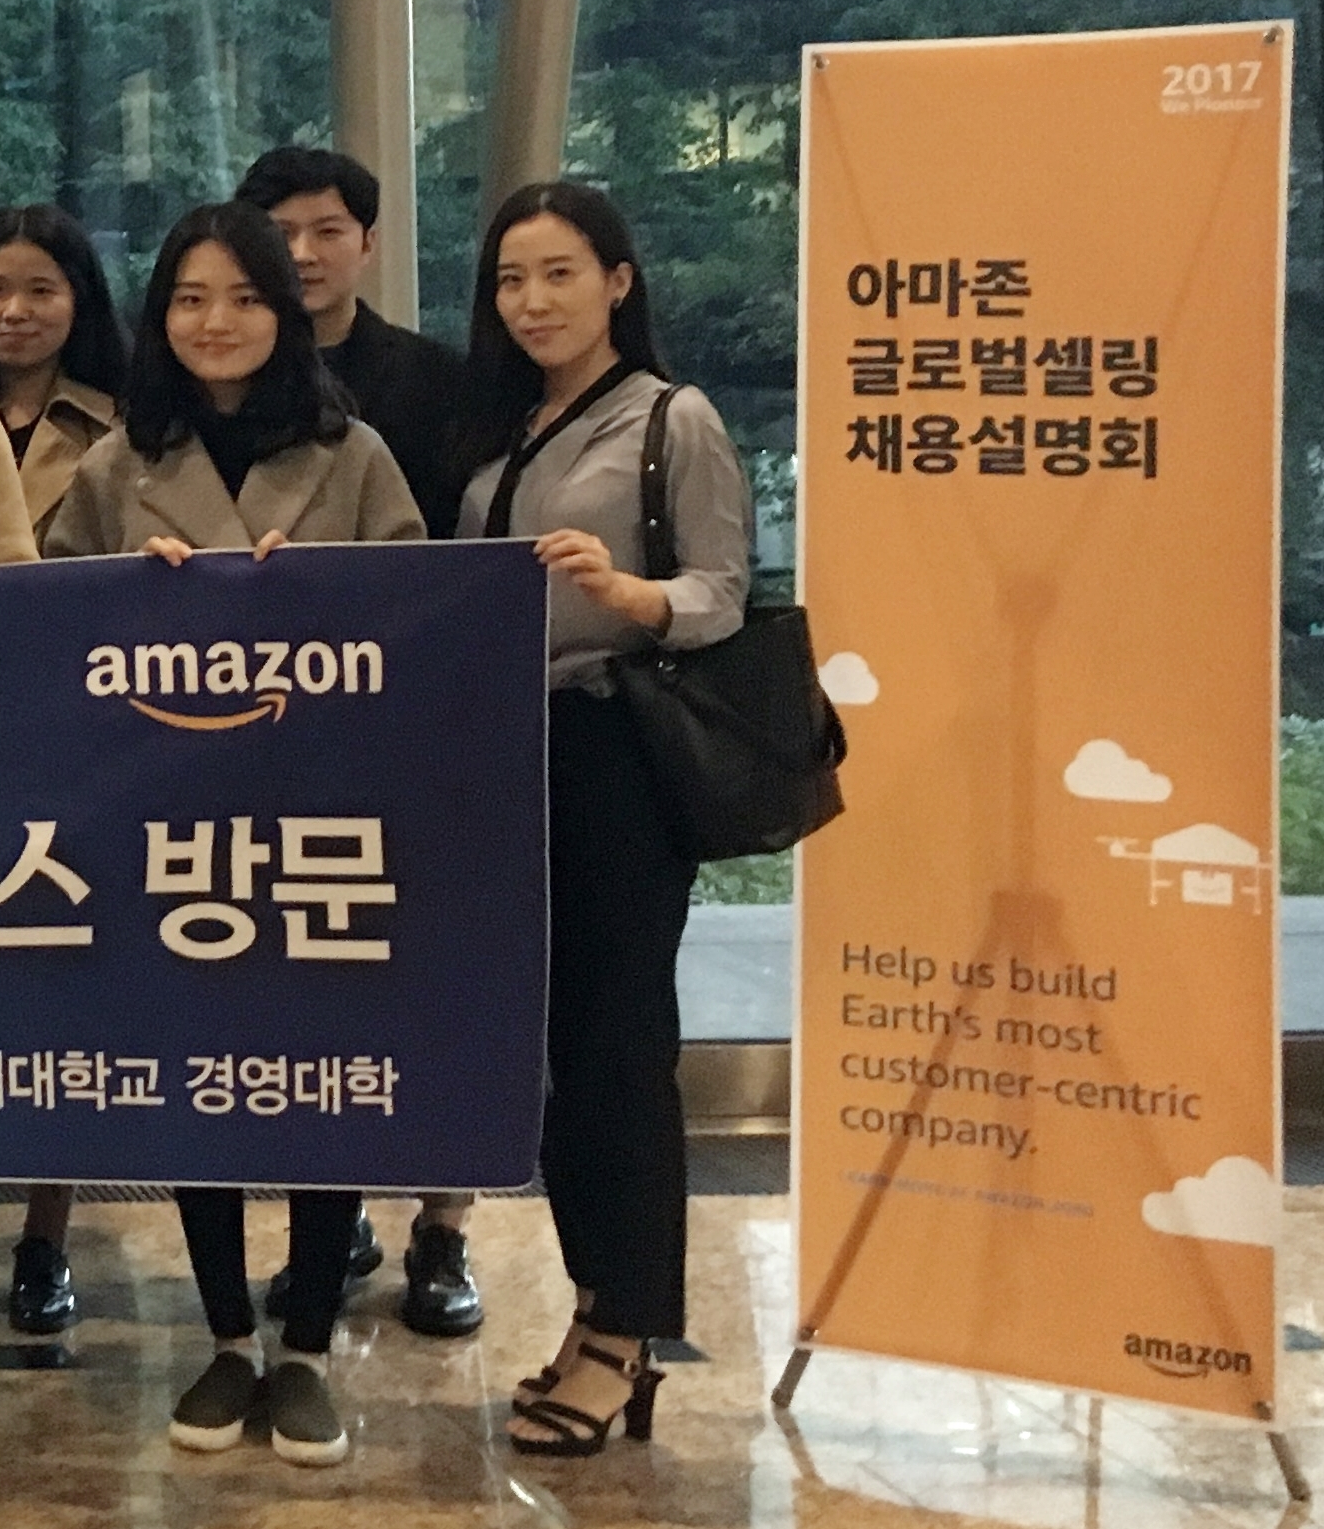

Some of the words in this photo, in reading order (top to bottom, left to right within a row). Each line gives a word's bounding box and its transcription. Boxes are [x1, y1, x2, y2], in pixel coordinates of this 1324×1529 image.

[1161, 60, 1263, 96] 2017
[846, 257, 1032, 319] 아마존
[846, 335, 1159, 398] 글로벌셀링
[846, 413, 1159, 480] 채용설명회
[84, 639, 385, 697] amazon
[143, 814, 398, 960] 방문
[841, 942, 937, 988] Help
[951, 959, 995, 991] us
[1009, 957, 1118, 1002] build
[841, 993, 982, 1041] Earth's
[995, 1016, 1104, 1055] most
[185, 1052, 401, 1117] 경영대학
[840, 1051, 1202, 1121] customer-centric
[840, 1103, 1039, 1160] company.
[1123, 1331, 1252, 1377] amazon
